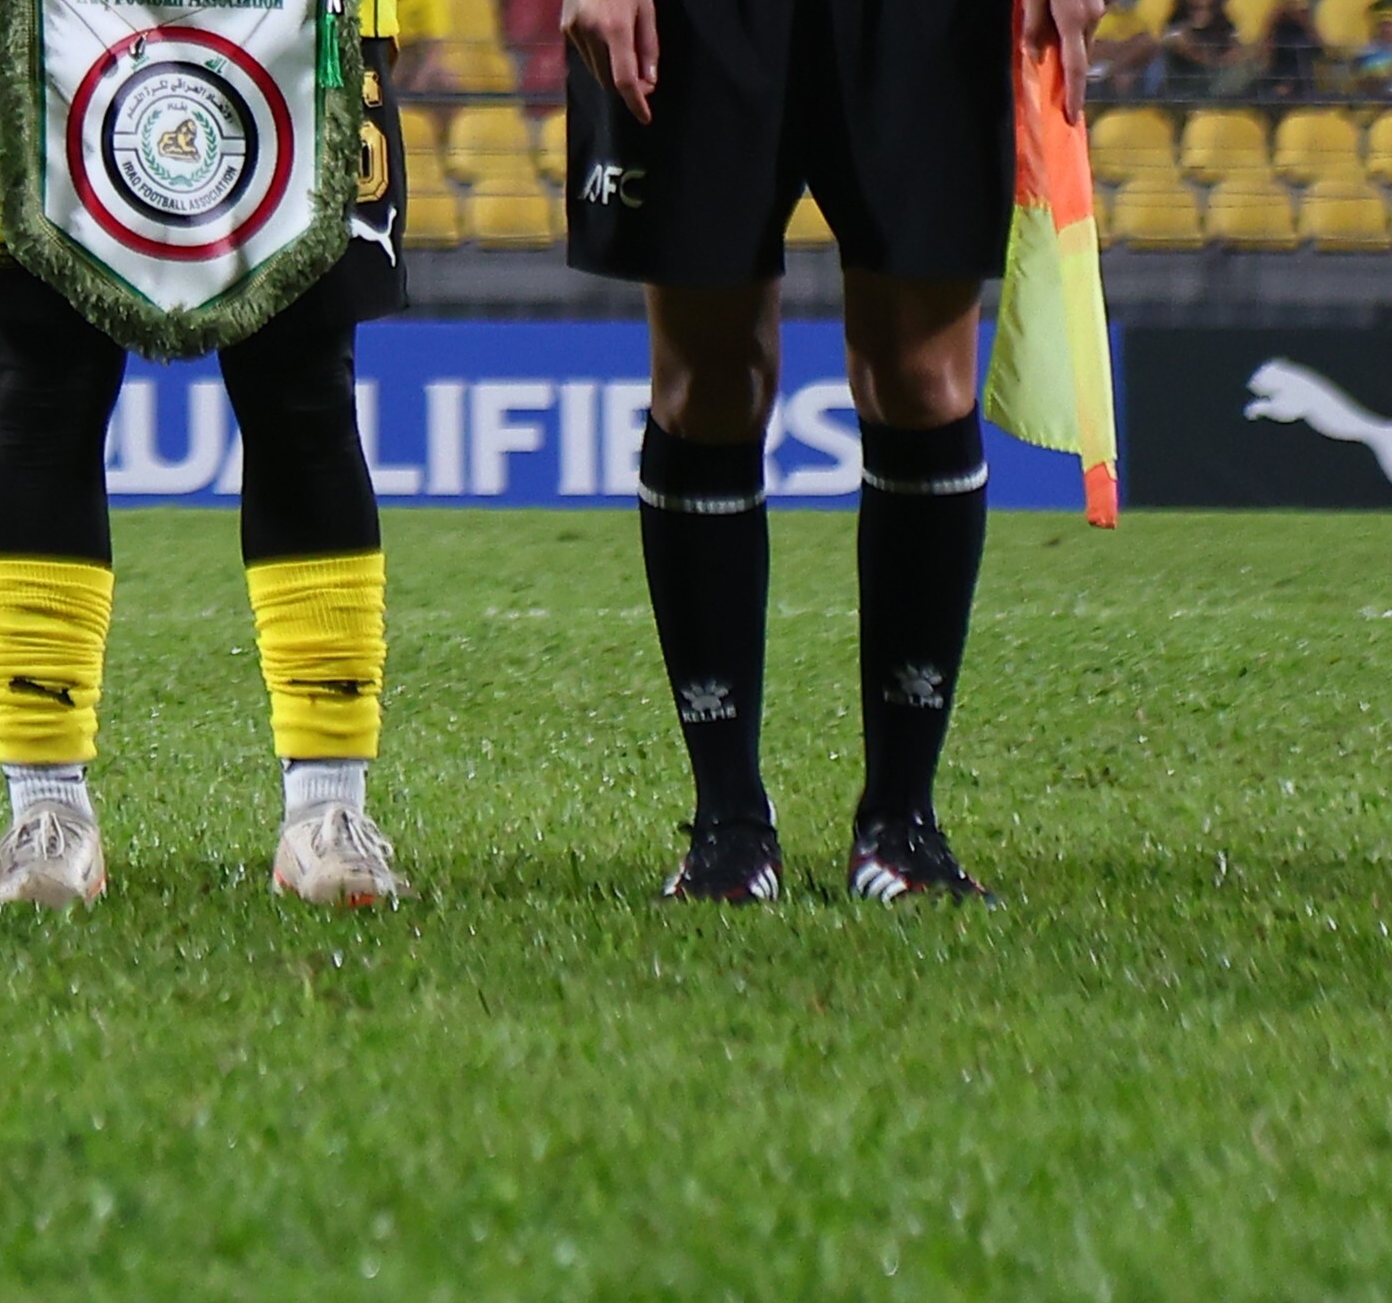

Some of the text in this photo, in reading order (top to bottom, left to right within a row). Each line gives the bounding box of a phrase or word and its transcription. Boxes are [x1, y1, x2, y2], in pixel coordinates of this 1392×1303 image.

[122, 161, 238, 212] IRAQ FOOTBALL ASSOCIATION
[579, 164, 646, 208] AFC
